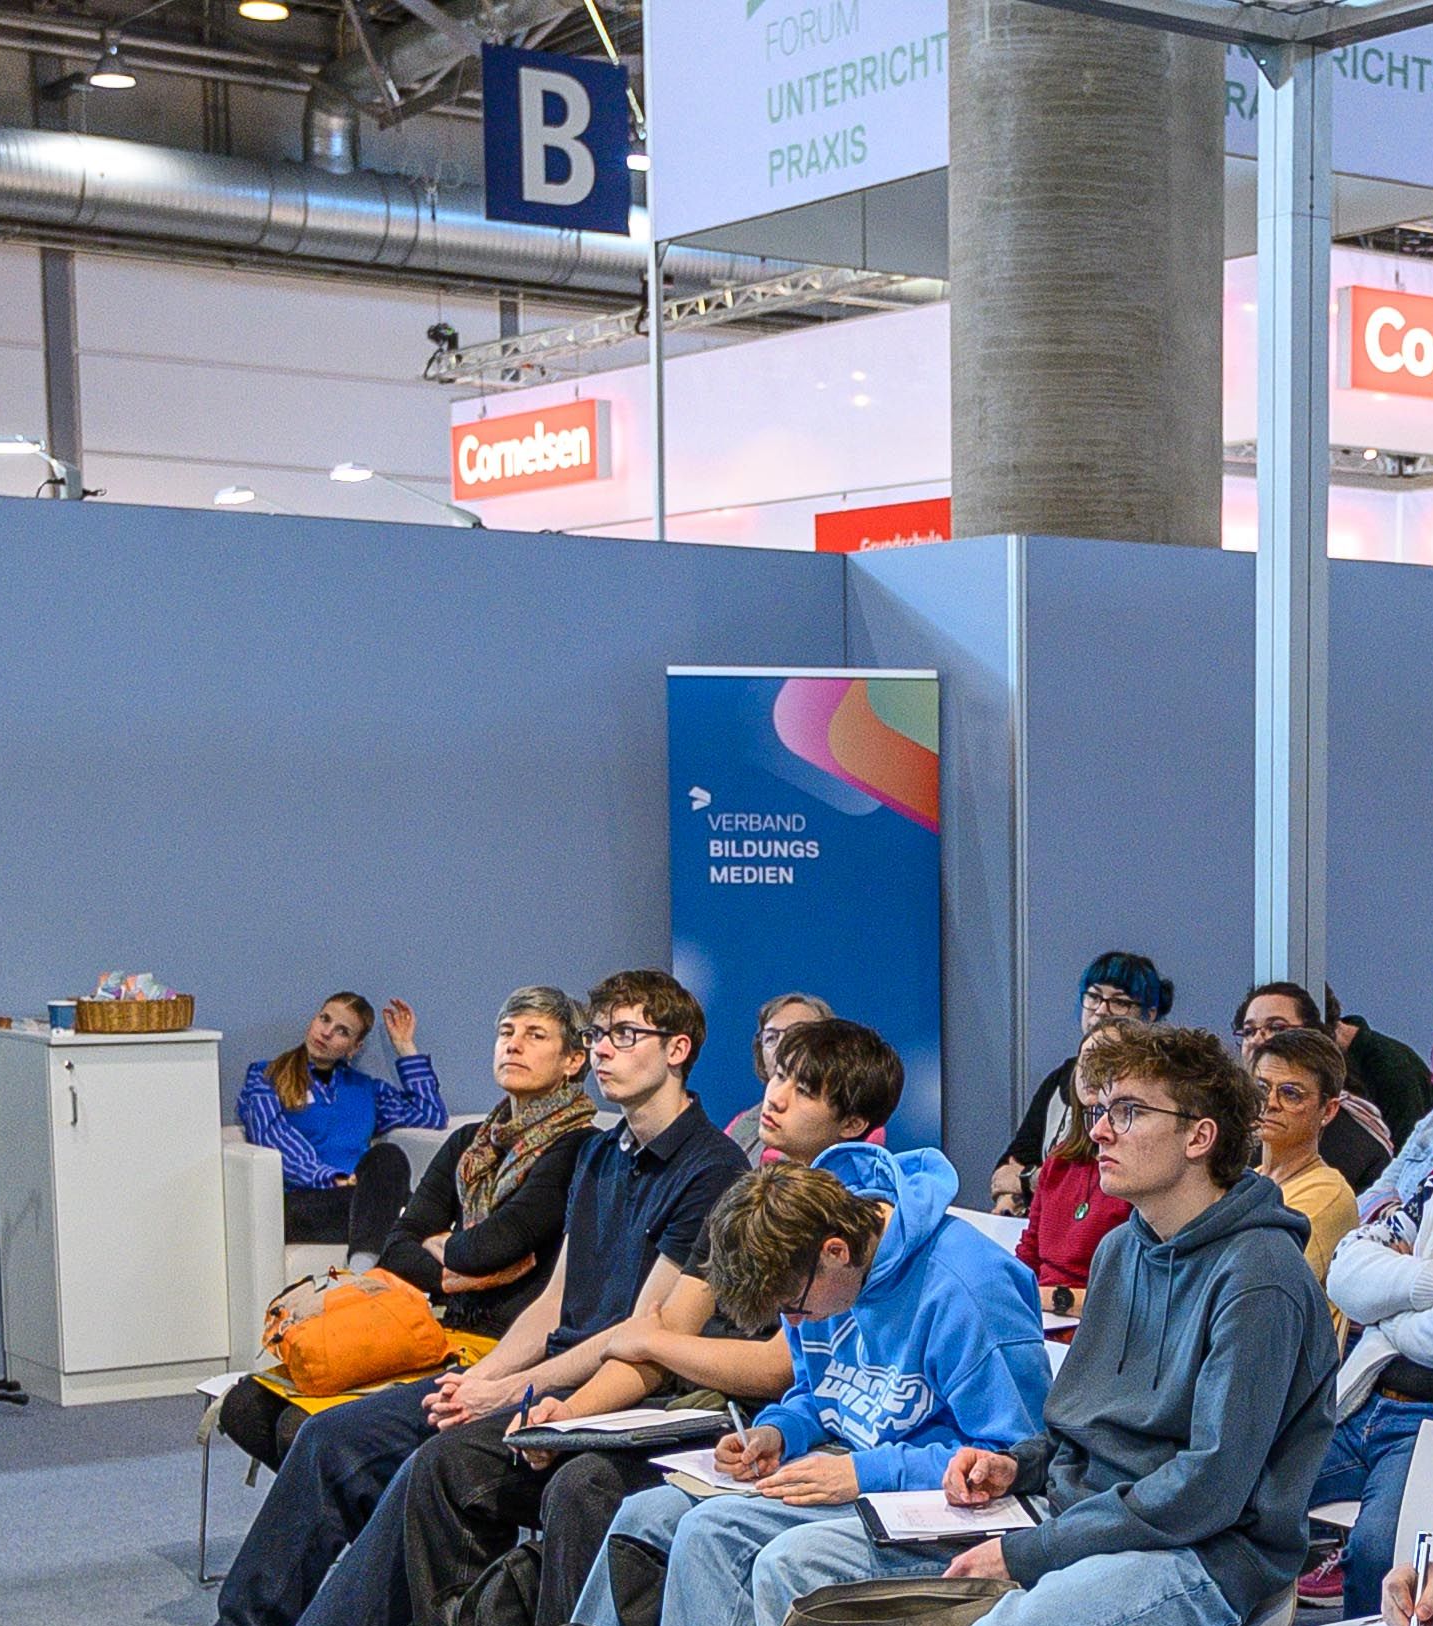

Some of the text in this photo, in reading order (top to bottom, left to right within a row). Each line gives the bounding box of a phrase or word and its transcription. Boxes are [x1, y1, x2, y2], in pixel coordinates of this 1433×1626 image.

[767, 0, 860, 61] FORUM
[519, 66, 596, 206] B
[769, 124, 866, 188] PRAXIS
[455, 421, 591, 486] Cornelsen
[707, 814, 807, 832] VERBAND
[709, 840, 820, 859] BILDUNGS
[710, 866, 794, 884] MEDIEN
